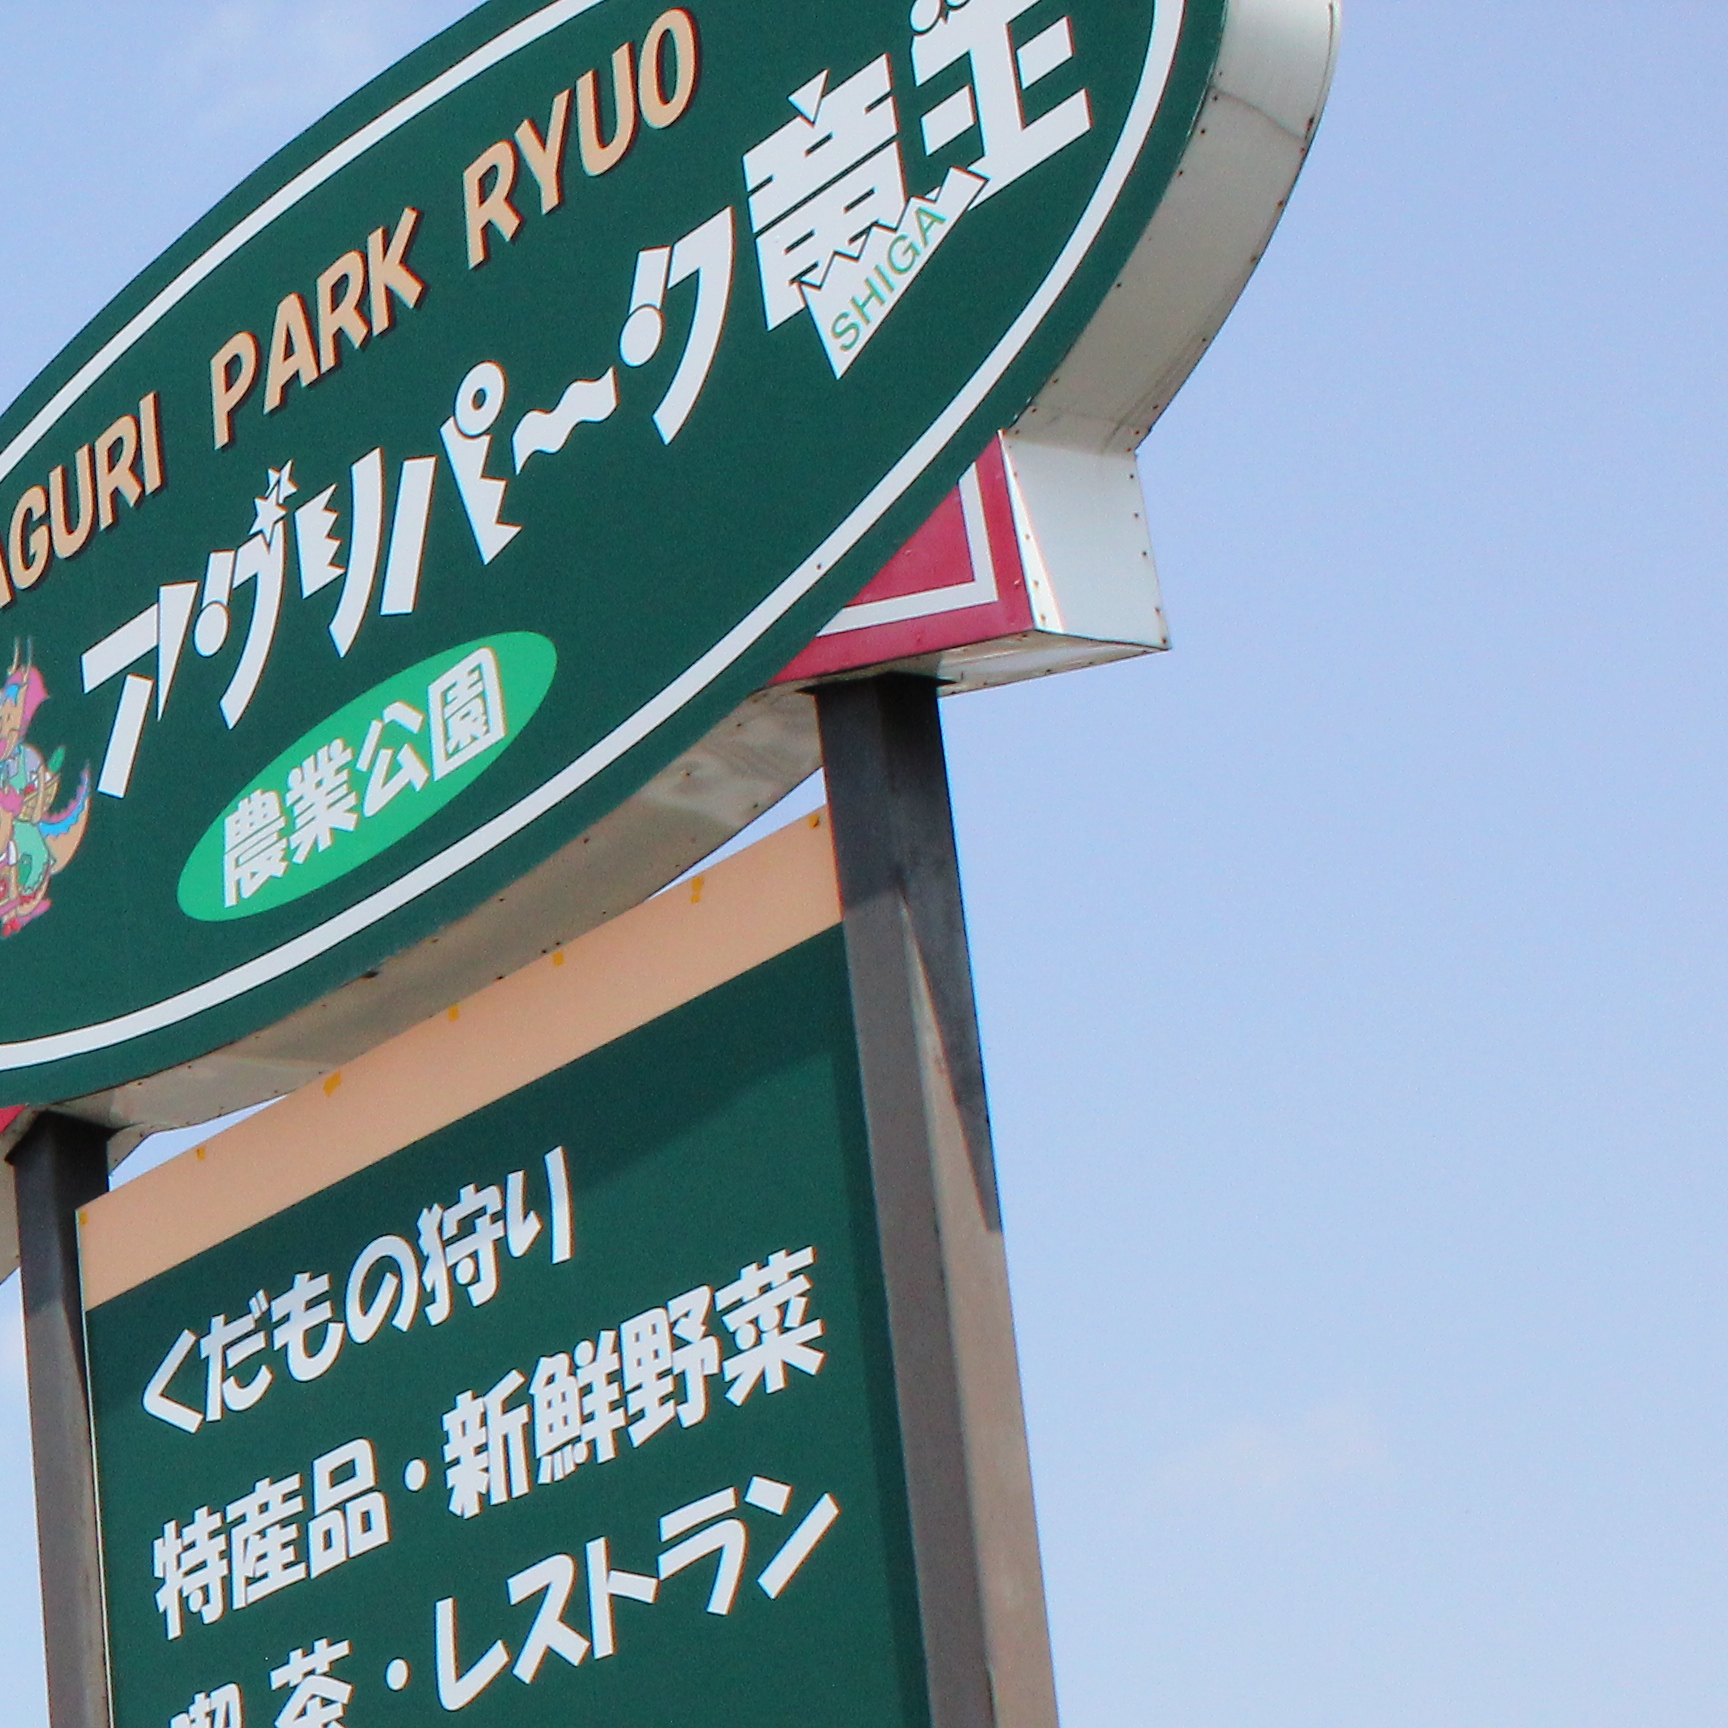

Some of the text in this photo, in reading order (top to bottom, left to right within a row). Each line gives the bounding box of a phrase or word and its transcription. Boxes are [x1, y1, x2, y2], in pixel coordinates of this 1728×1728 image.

[211, 207, 426, 449] PARK
[464, 6, 704, 272] RYUO
[830, 206, 947, 353] SHIGA
[221, 645, 505, 908] 農業公園
[143, 1145, 573, 1434] くだもの狩り
[153, 1244, 826, 1640] 特産品・新鮮野菜
